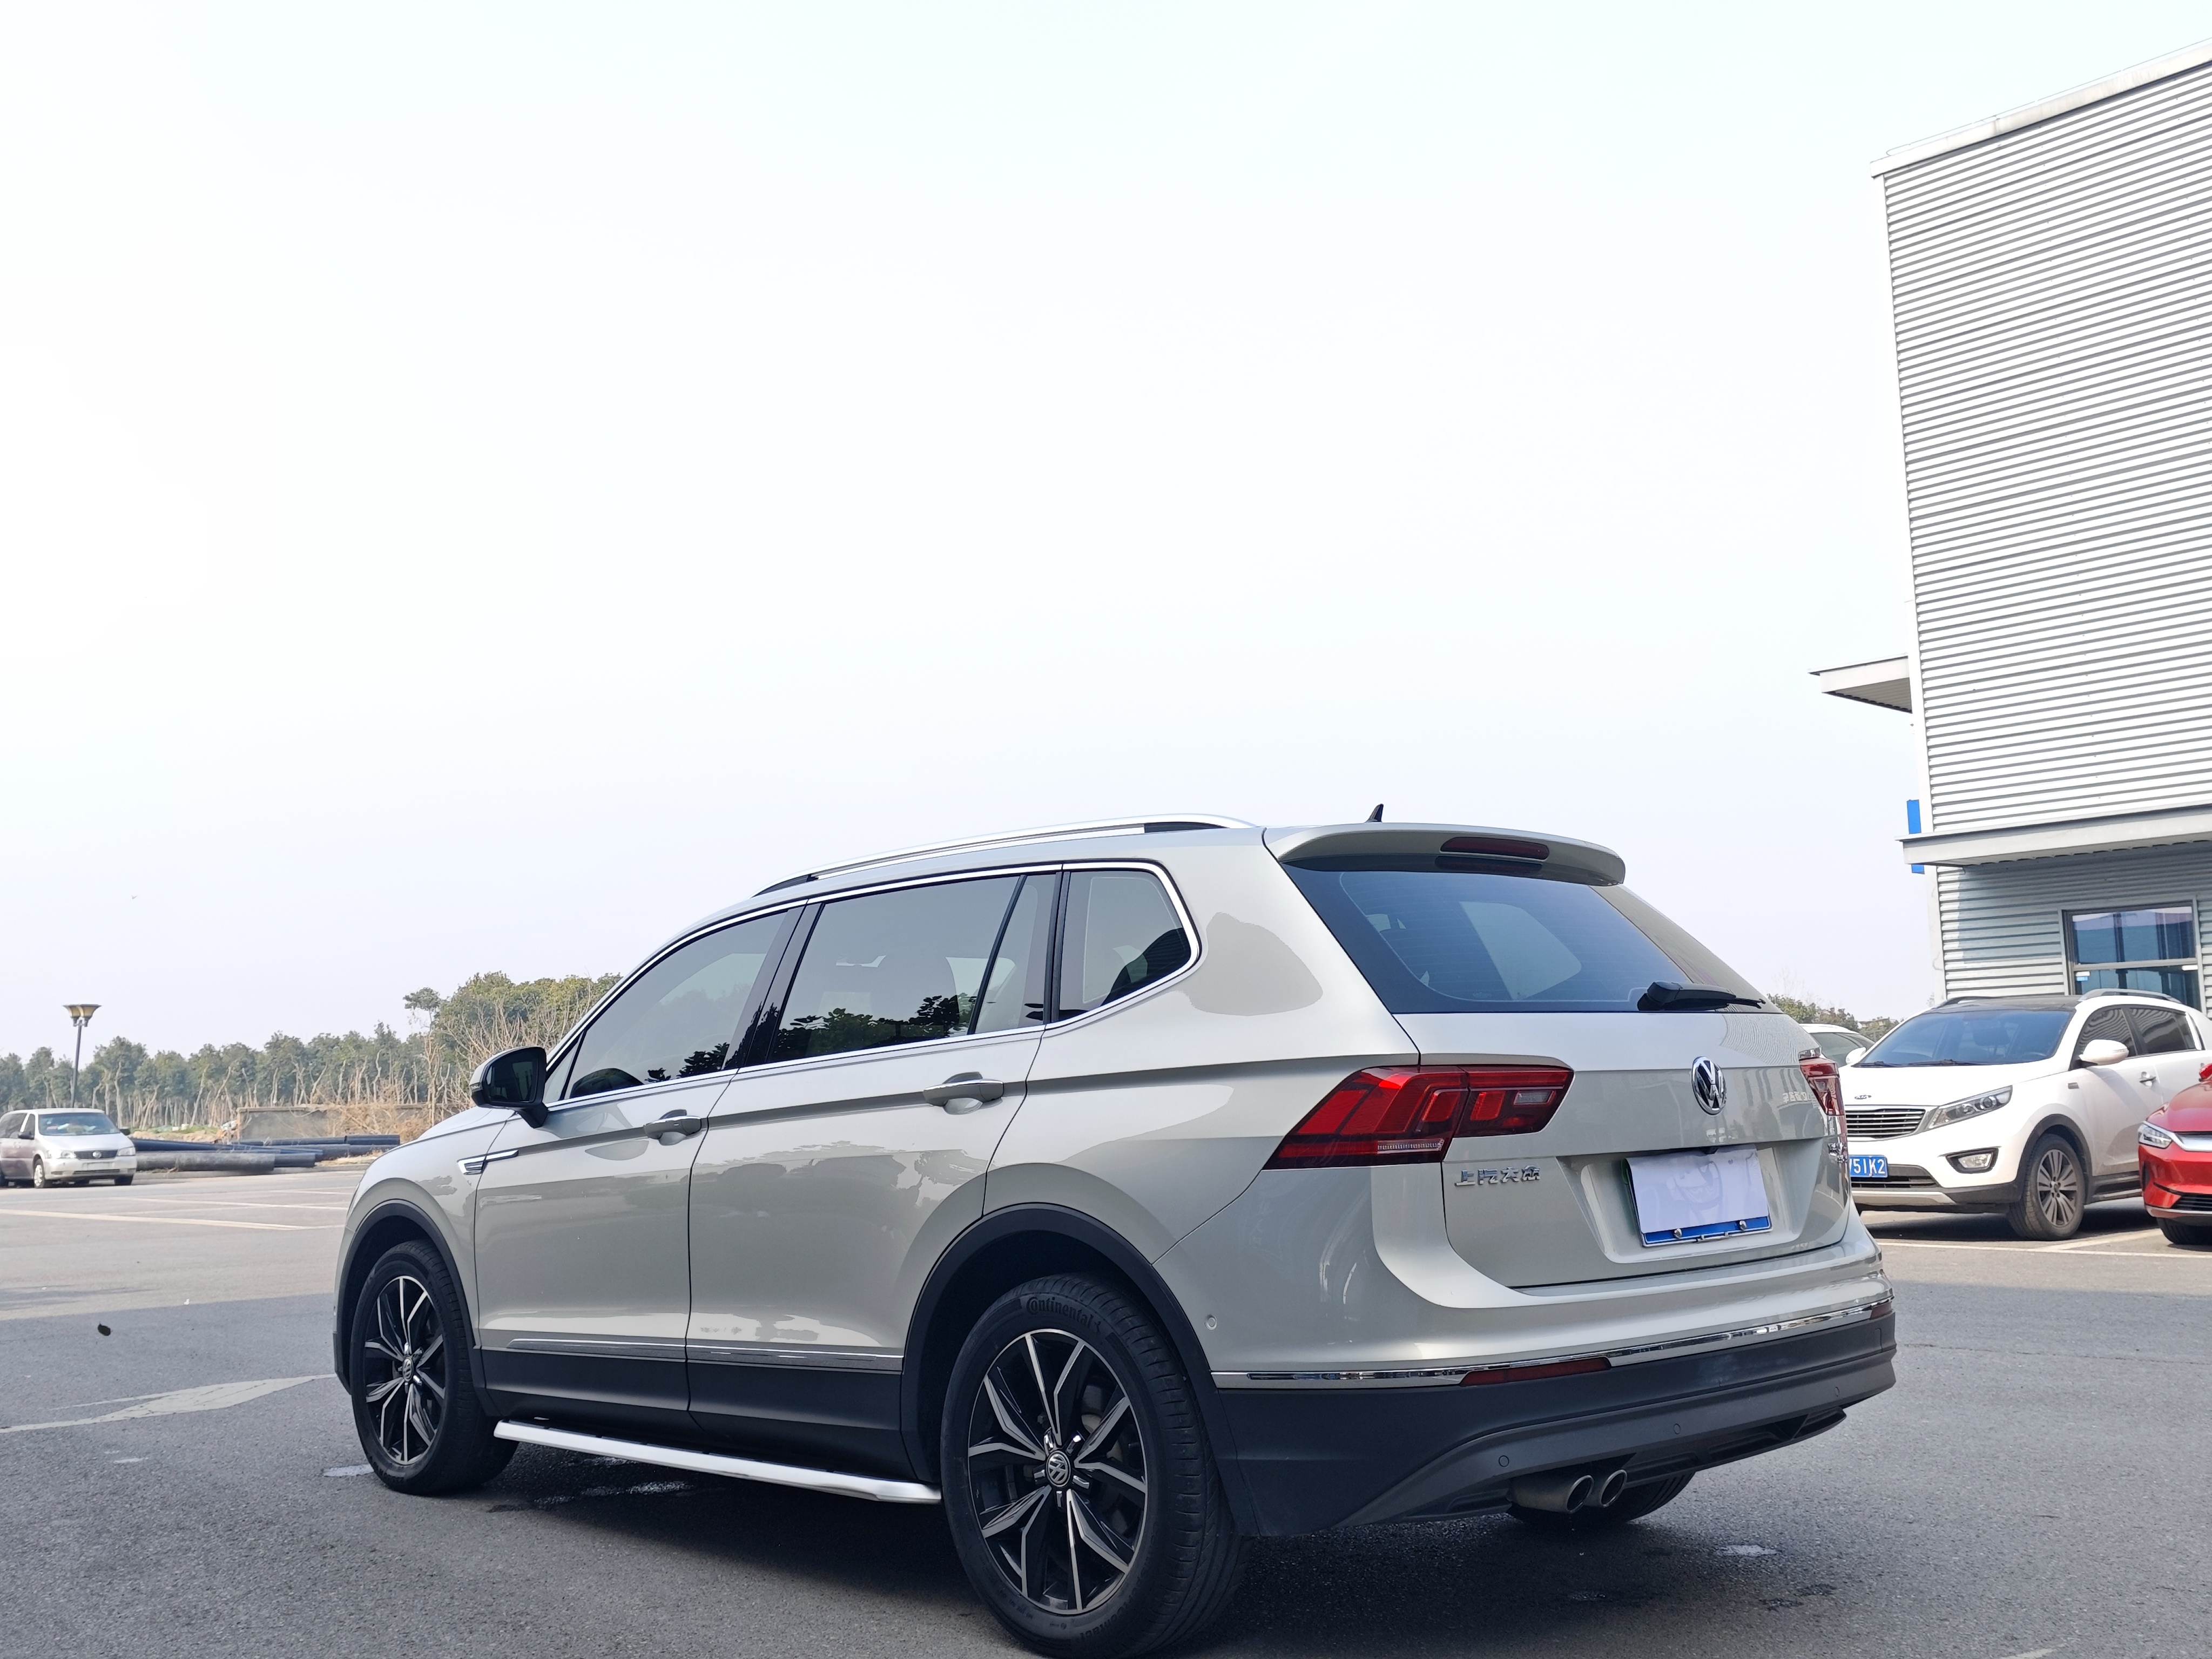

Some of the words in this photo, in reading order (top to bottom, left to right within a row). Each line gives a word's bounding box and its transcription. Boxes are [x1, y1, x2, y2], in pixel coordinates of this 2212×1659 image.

[1454, 1165, 1541, 1187] 上汽大众
[1026, 1296, 1094, 1329] Continental
